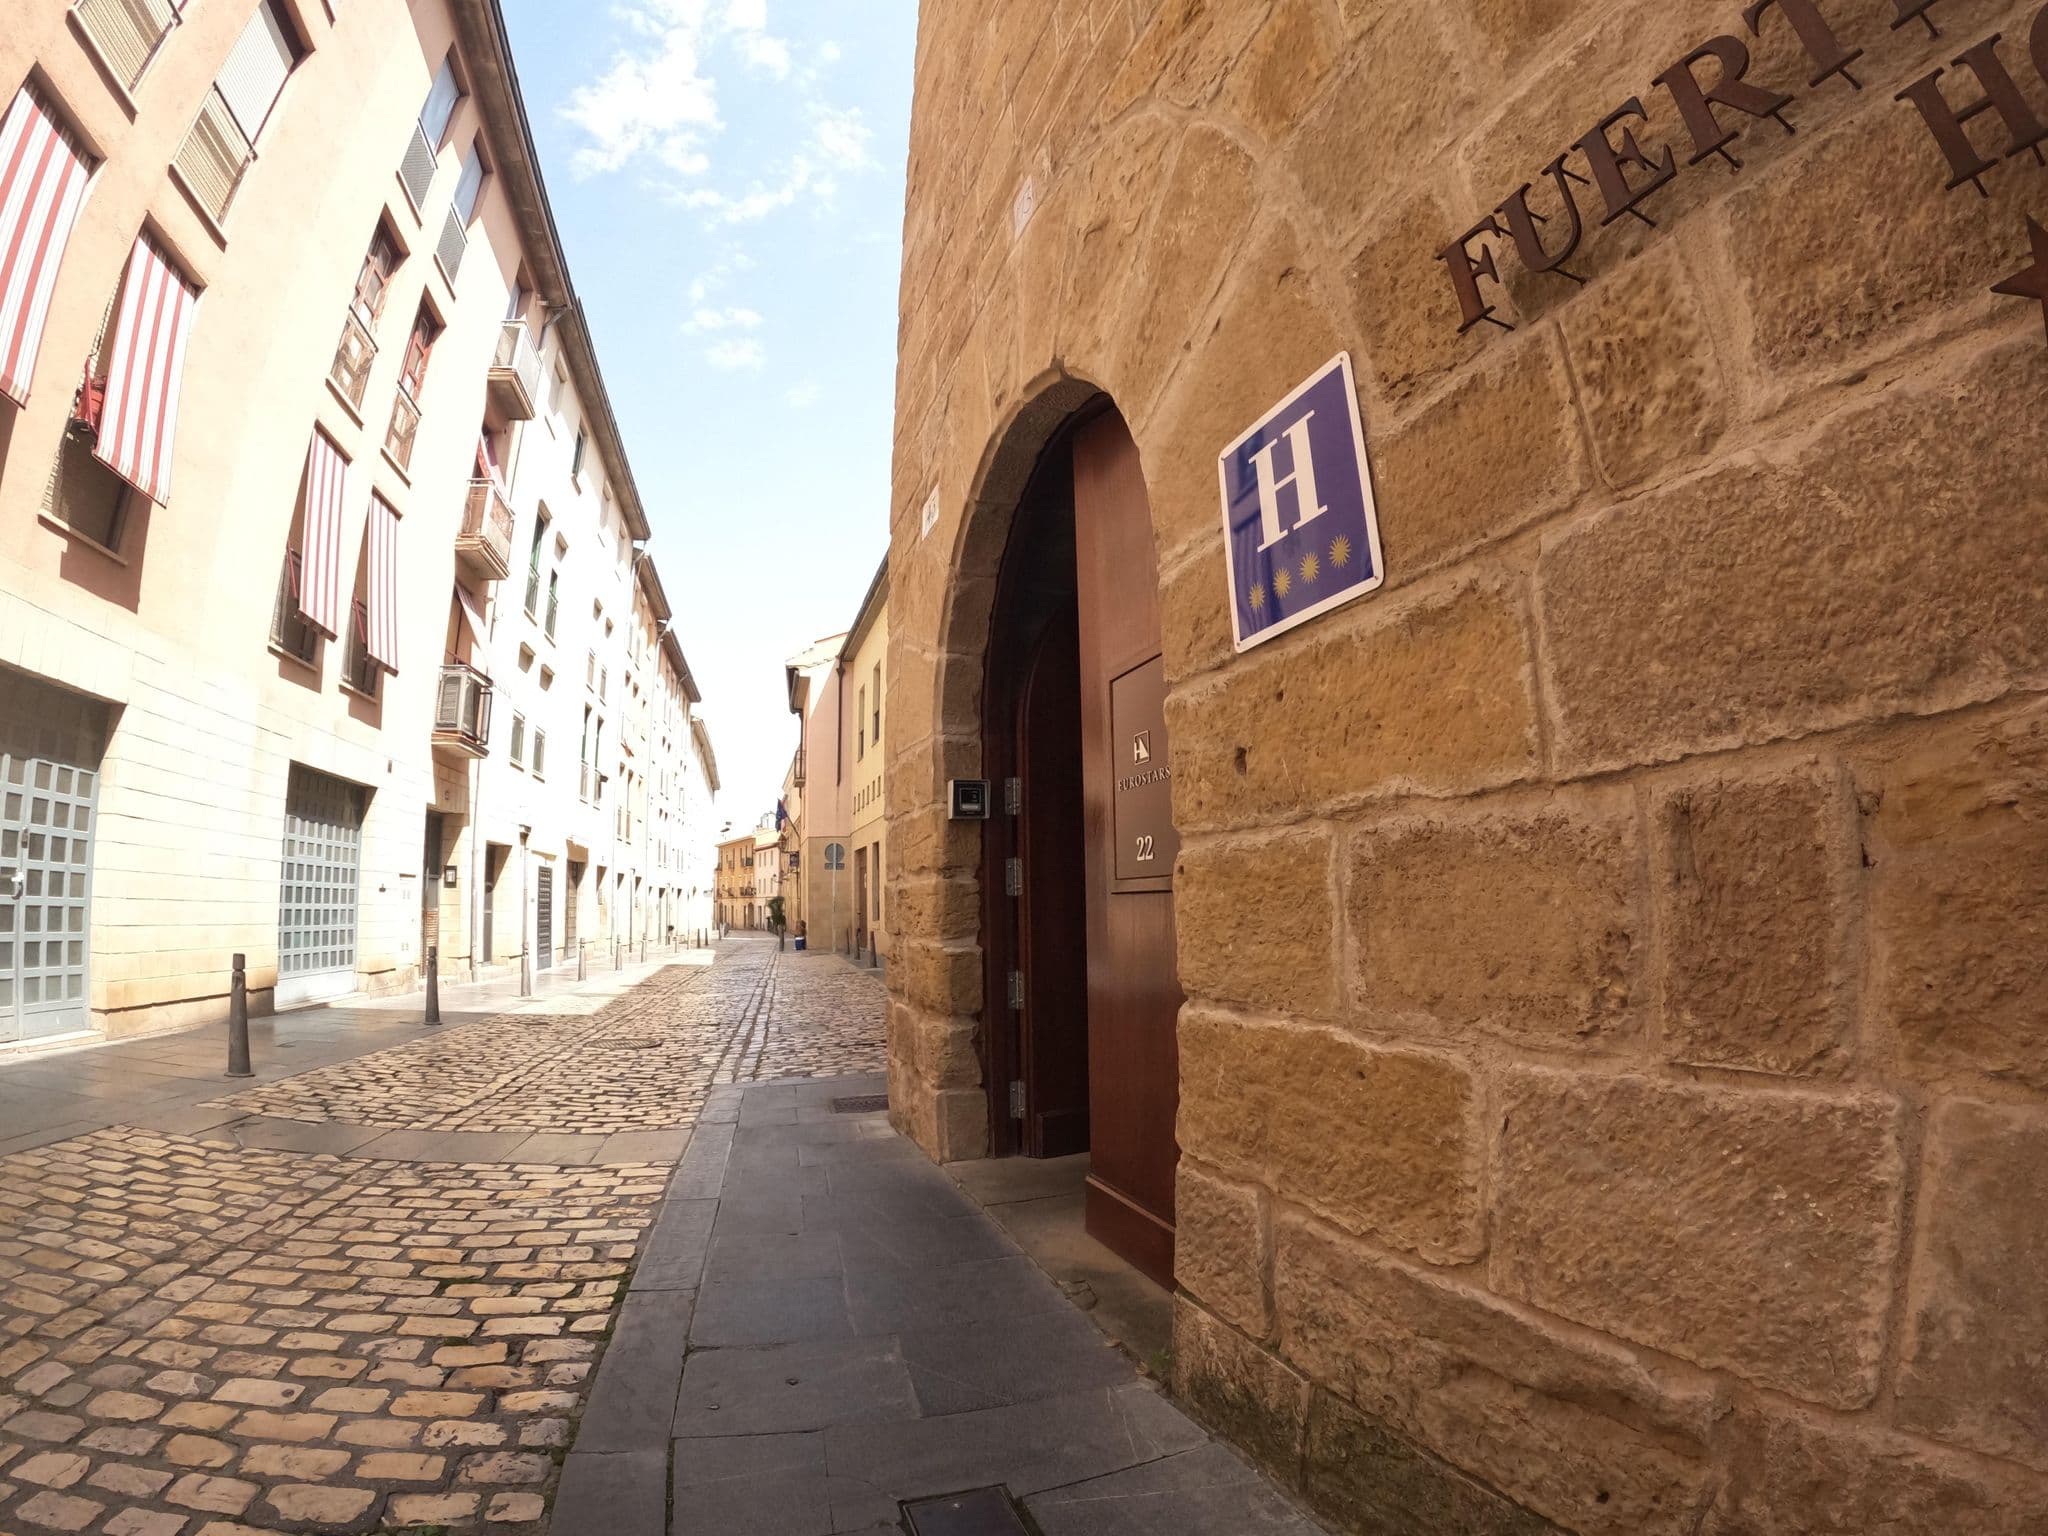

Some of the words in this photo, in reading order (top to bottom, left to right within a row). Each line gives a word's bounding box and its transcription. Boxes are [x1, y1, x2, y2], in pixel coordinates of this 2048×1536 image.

[1435, 0, 1941, 333] FUERT
[1894, 2, 2048, 191] H
[1248, 409, 1328, 553] H
[1118, 765, 1171, 791] EUROSTARS
[1136, 835, 1154, 861] 22
